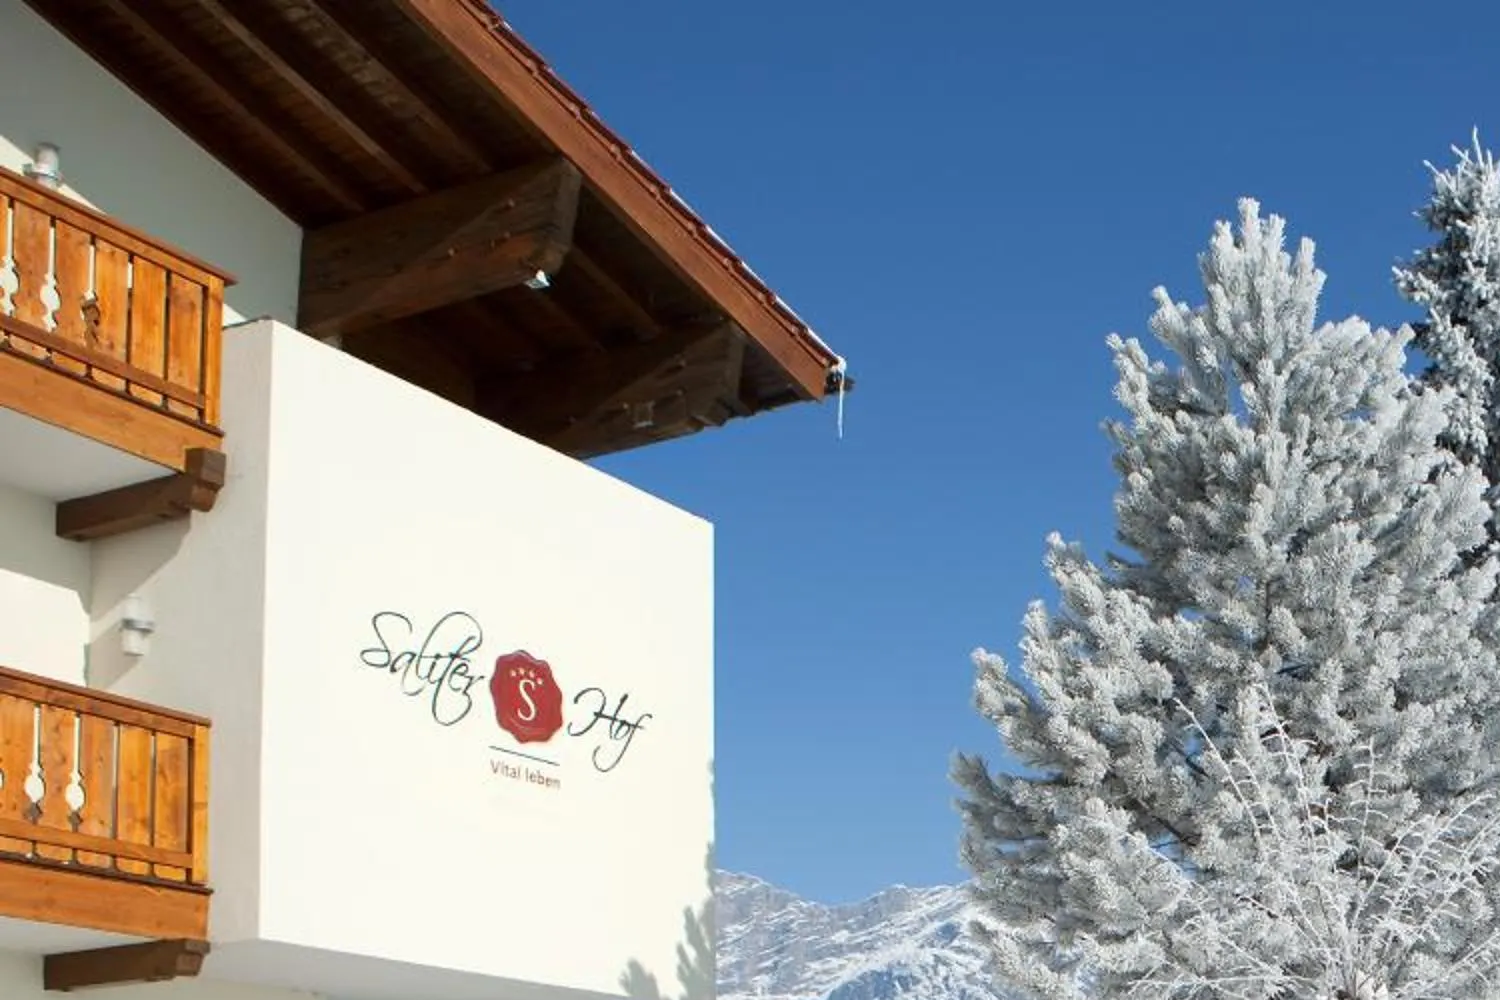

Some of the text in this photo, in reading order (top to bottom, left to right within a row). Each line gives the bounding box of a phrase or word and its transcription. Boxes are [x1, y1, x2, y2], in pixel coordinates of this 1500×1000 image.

[517, 679, 536, 721] S
[567, 687, 653, 773] Hof
[489, 758, 561, 790] Vital leben
